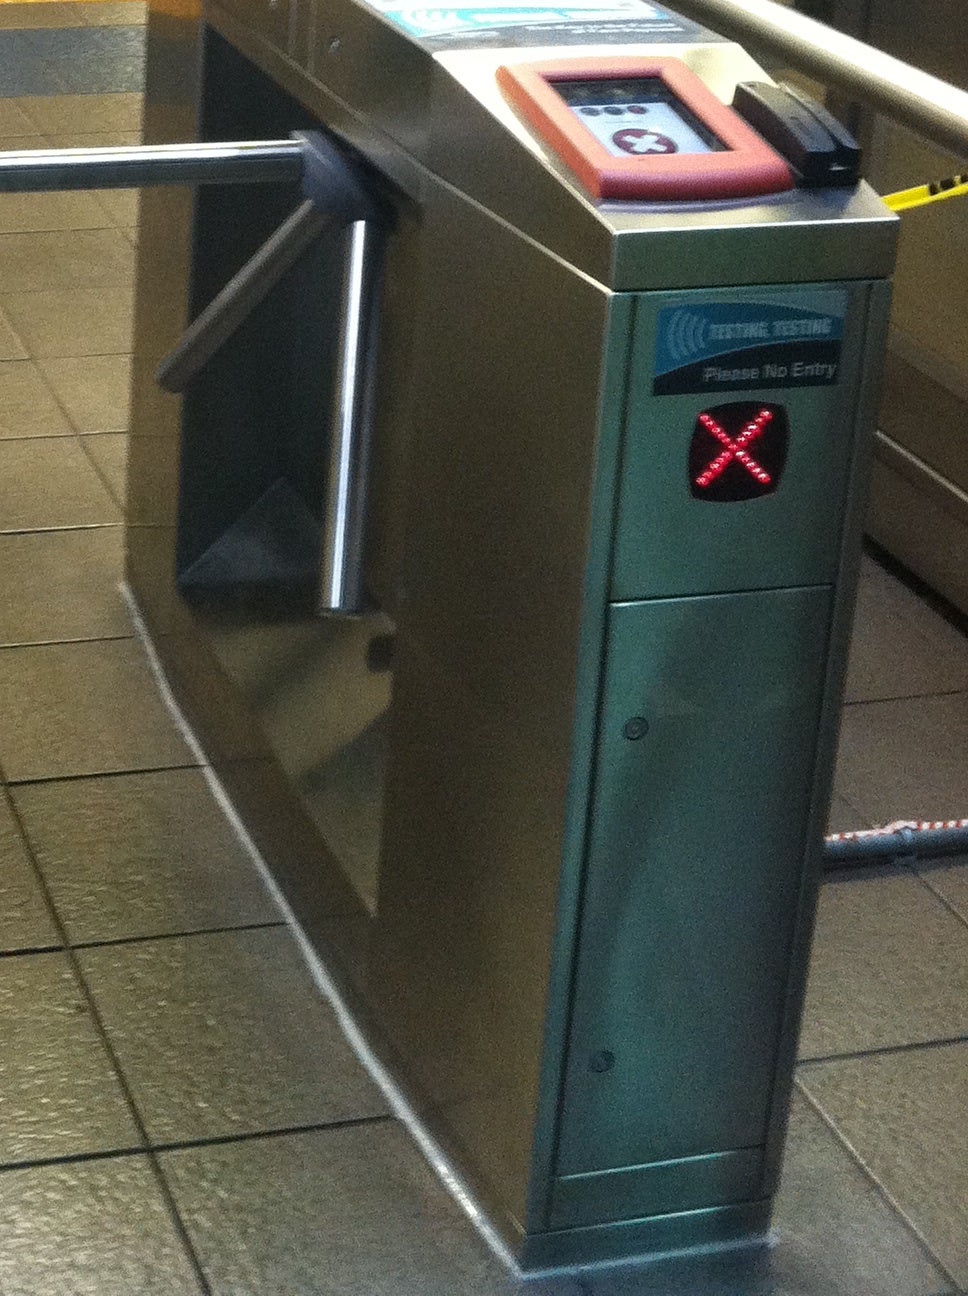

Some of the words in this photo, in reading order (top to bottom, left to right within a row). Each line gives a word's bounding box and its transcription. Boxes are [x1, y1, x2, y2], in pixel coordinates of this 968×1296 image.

[702, 366, 760, 383] Please
[762, 364, 788, 378] No
[791, 361, 837, 380] Entry
